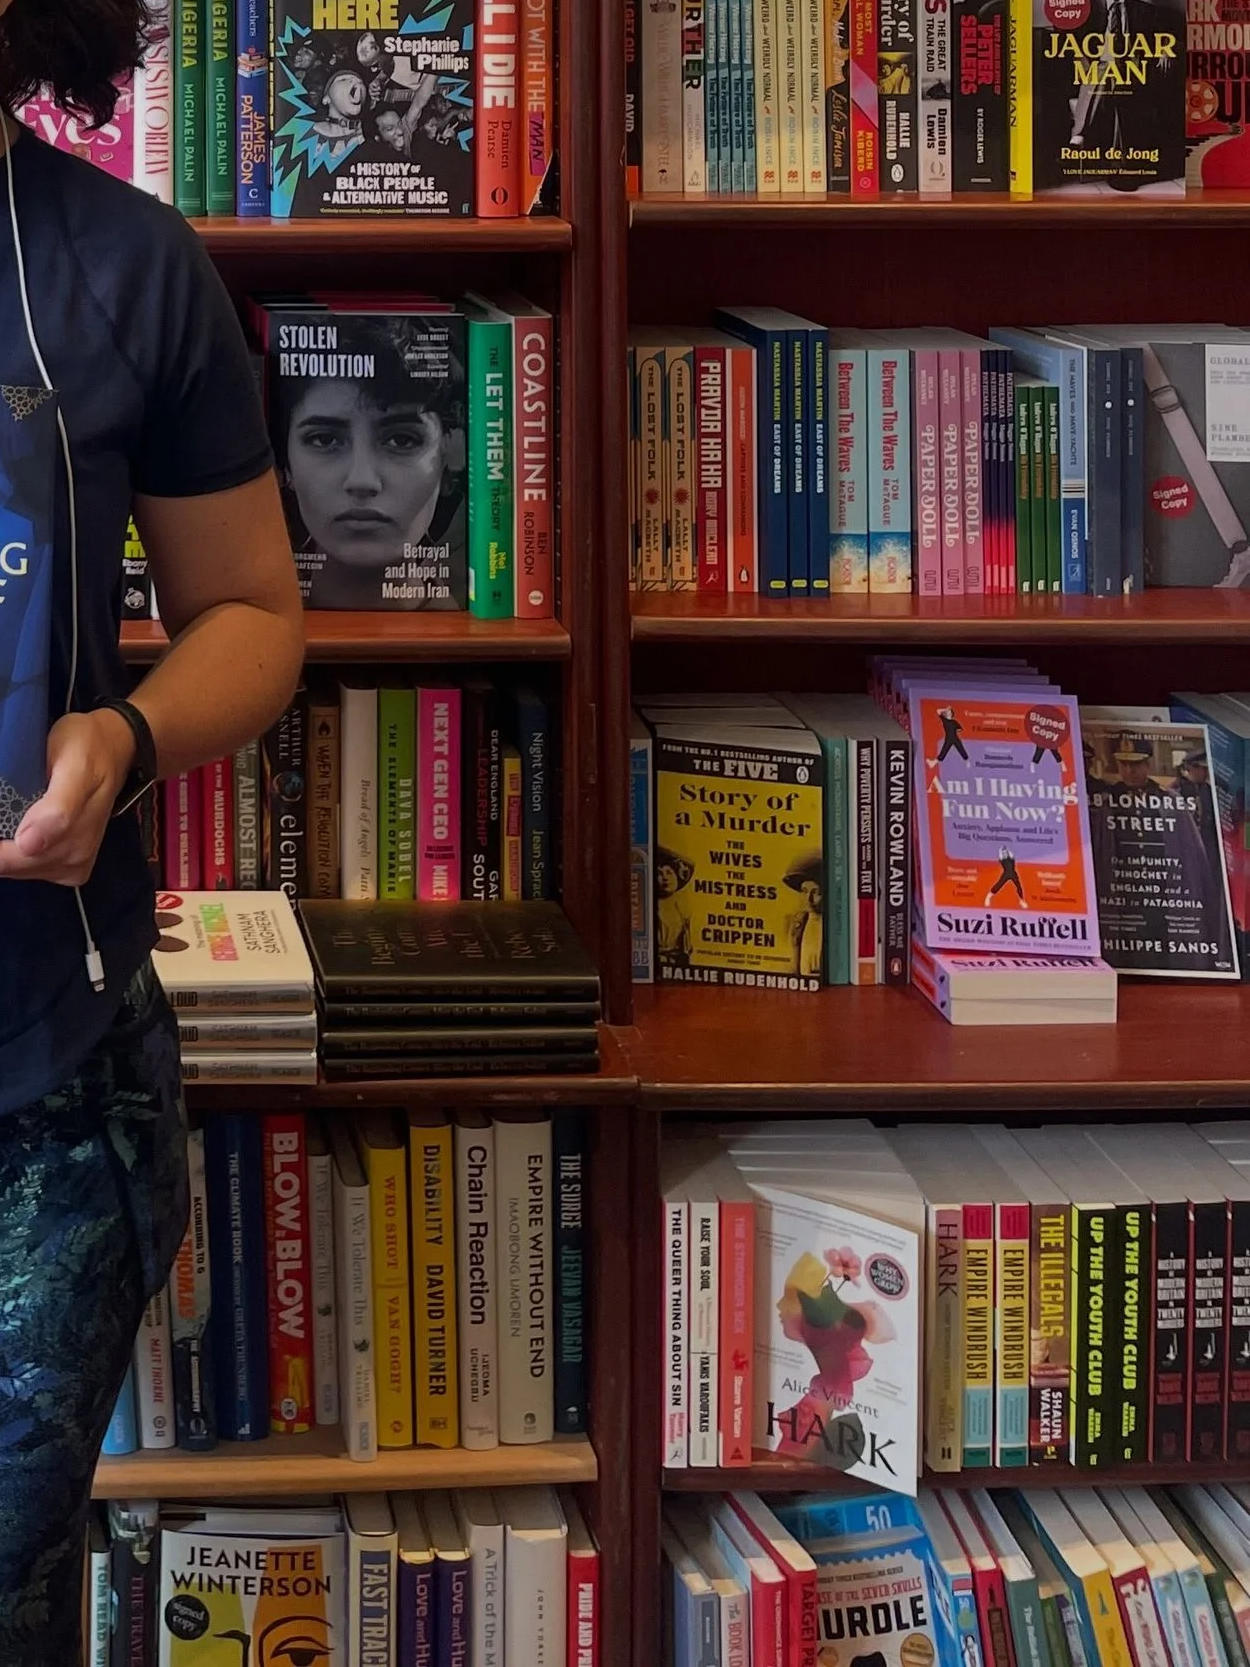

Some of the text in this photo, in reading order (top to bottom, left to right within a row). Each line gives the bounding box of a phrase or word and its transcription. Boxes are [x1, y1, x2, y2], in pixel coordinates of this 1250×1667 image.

[1055, 7, 1082, 20] Copy
[384, 36, 459, 55] Stephanie
[484, 34, 515, 43] I
[1044, 33, 1176, 60] JAGUAR
[417, 53, 469, 72] Phillips
[1073, 61, 1147, 85] MAN
[484, 50, 515, 109] DIE
[1061, 147, 1159, 163] Raoul de Jong
[279, 325, 337, 350] STOLEN
[280, 354, 374, 378] REVOLUTION
[485, 372, 504, 480] LET THEM
[522, 333, 547, 502] COASTLINE
[403, 543, 449, 560] Betrayal
[385, 563, 449, 581] and Hope in
[382, 583, 449, 599] Modern Iran
[680, 784, 799, 812] Story of
[1108, 793, 1196, 812] LONDRES
[675, 806, 811, 838] a Murder
[890, 749, 905, 907] KEVIN ROWLAND
[1106, 815, 1176, 832] STREET
[936, 913, 1088, 941] Suzi Ruffell
[662, 966, 820, 992] HALLIE RUBENHOLD
[271, 1132, 305, 1339] BLOW BLOW
[782, 1376, 820, 1397] Alice
[823, 1387, 880, 1419] Vincent
[765, 1401, 898, 1478] HARK
[186, 1546, 316, 1571] JEANETTE
[171, 1570, 332, 1596] WINTERSON
